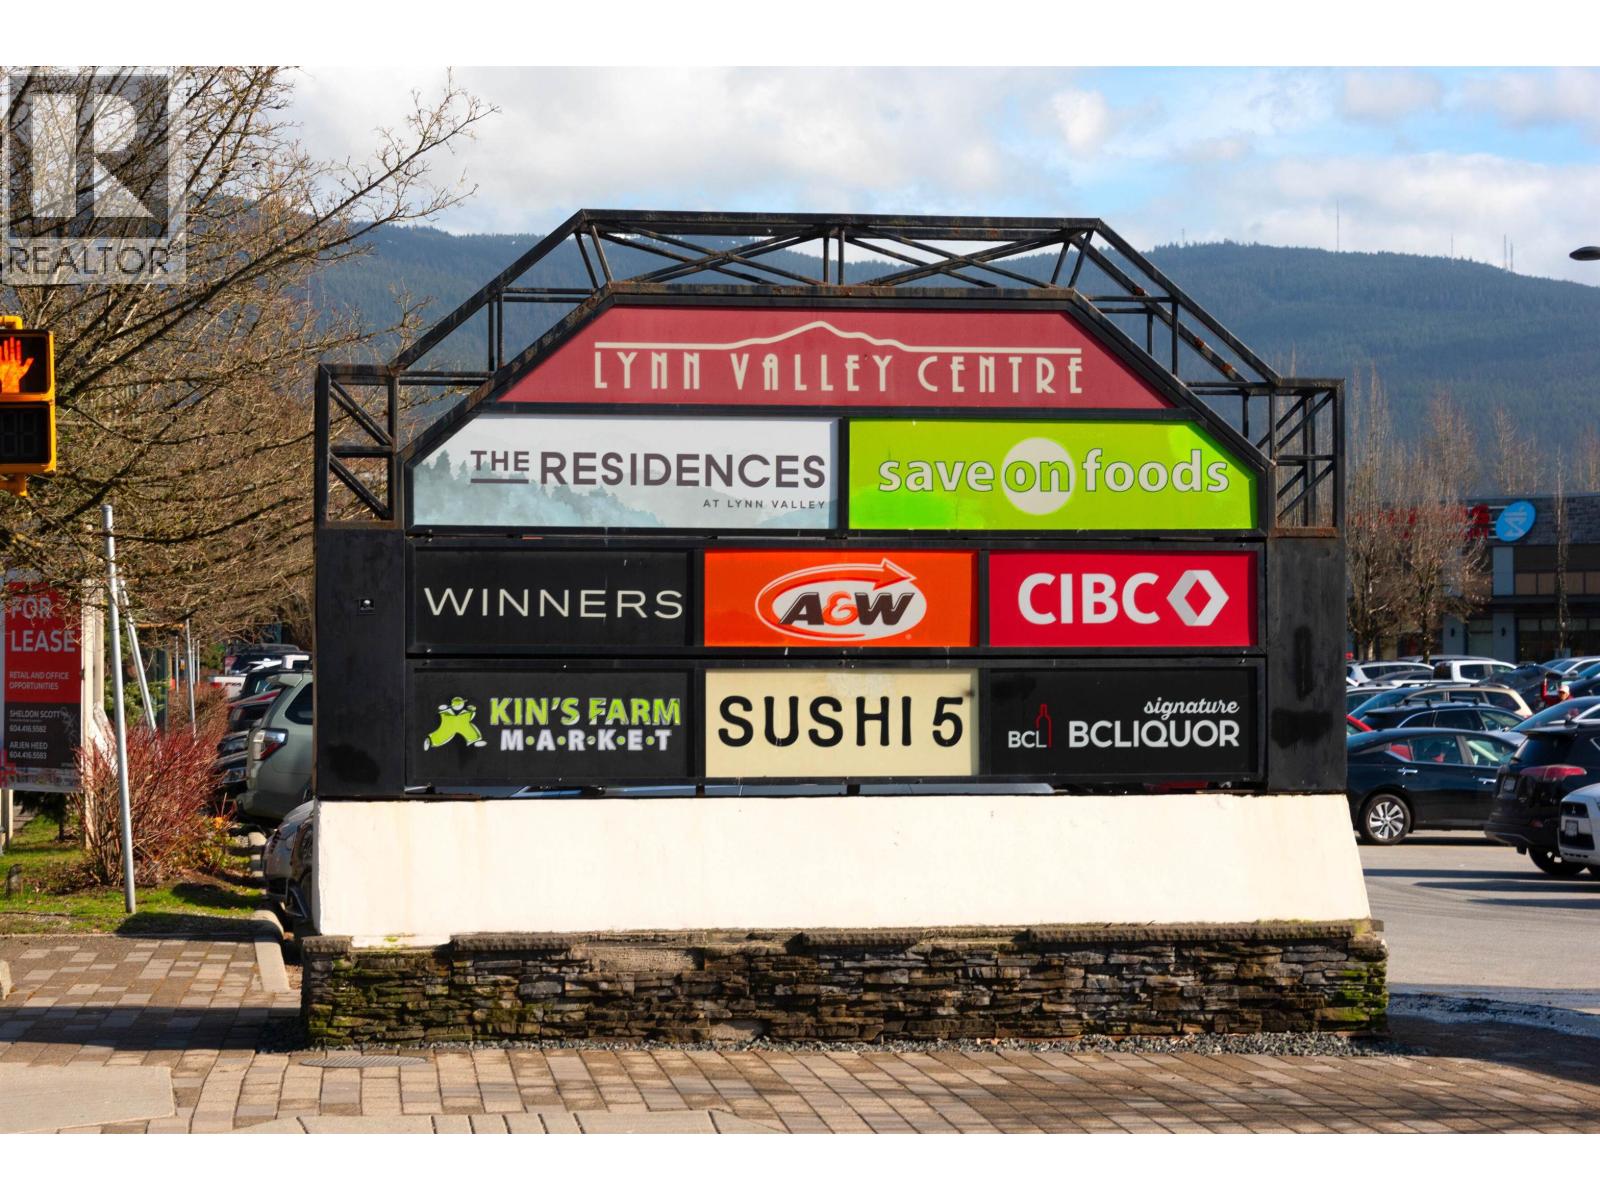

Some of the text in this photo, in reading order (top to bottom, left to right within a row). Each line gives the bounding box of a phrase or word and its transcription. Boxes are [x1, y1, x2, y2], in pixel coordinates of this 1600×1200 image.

[594, 352, 1083, 394] LYNN VALLEY CENTRE
[470, 450, 826, 489] THE RESIDENCES
[878, 448, 1231, 492] save on foods
[703, 499, 826, 509] AT LYNN VALLEY
[11, 596, 52, 619] FOR
[424, 587, 684, 619] WINNERS
[778, 591, 915, 627] A&W
[1018, 572, 1161, 625] CIBC
[11, 629, 75, 652] LEASE
[9, 671, 70, 680] RETAIL AND OFFICE
[9, 681, 59, 690] OPPORTUNITIES
[10, 710, 61, 718] SHELDON SCOTT
[490, 697, 681, 726] KIN'S FARM
[718, 695, 964, 747] SUSHI 5
[1143, 697, 1240, 721] signature
[1008, 731, 1047, 748] BCL
[1068, 720, 1240, 748] BCLIQUOR
